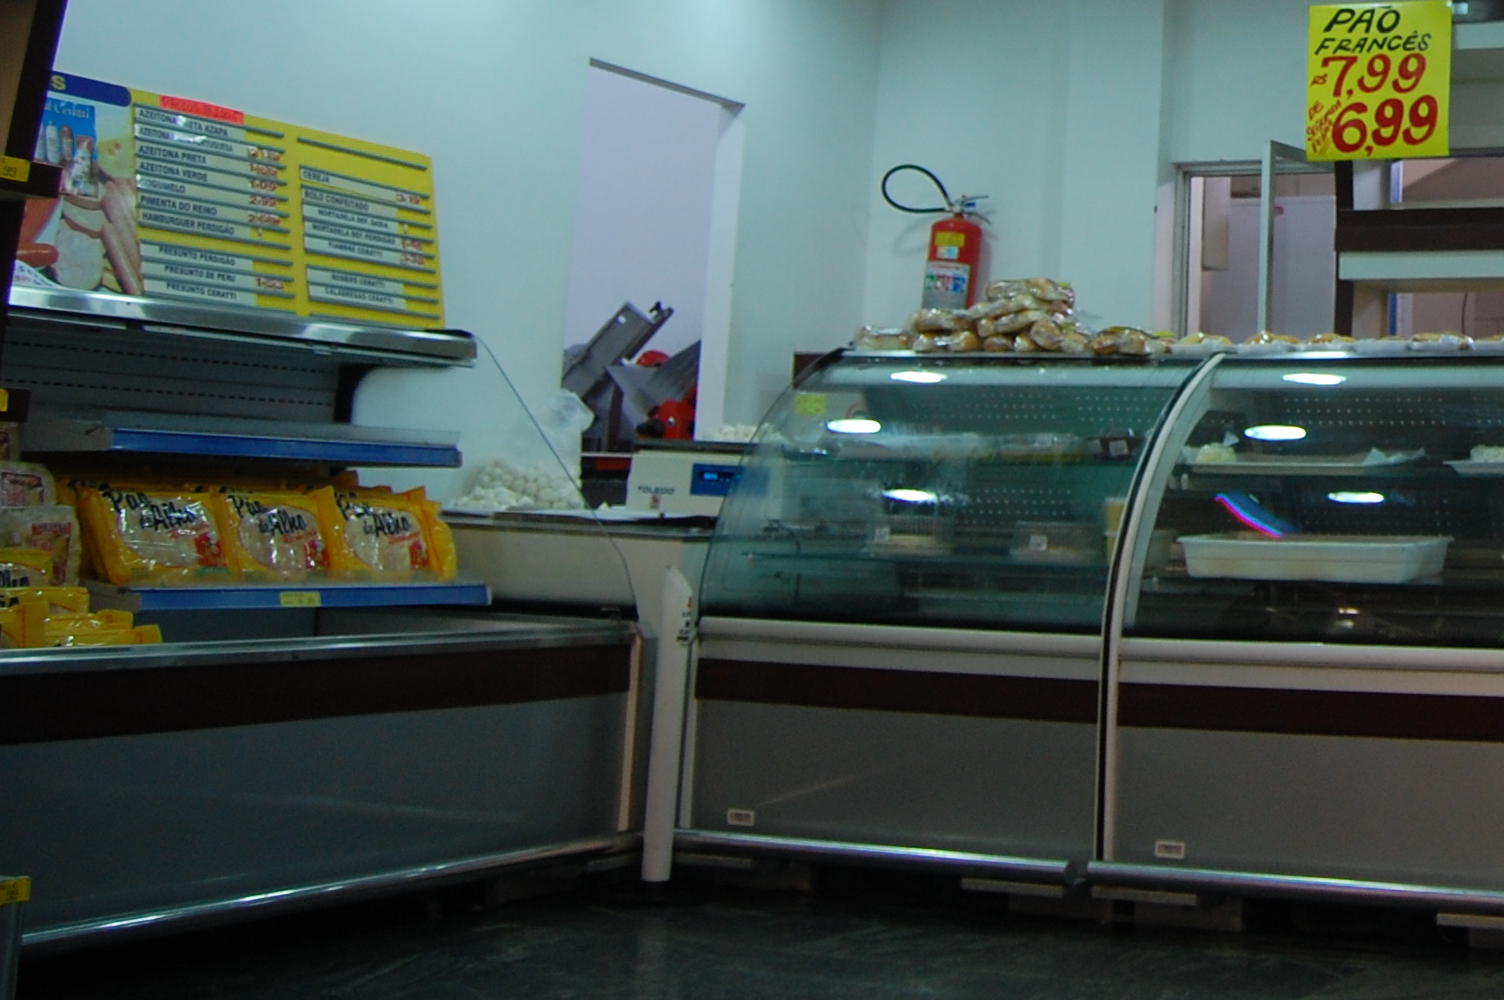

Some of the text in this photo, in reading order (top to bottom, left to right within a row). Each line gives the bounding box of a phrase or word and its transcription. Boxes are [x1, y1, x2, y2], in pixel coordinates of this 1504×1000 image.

[1323, 6, 1401, 34] PÃO
[1314, 30, 1433, 56] FRANCÊS
[1321, 53, 1428, 100] 7,99
[1332, 94, 1439, 157] 6,99
[140, 144, 207, 165] AZEITONA PRETA
[140, 160, 208, 182] AZEITONA VERDE
[140, 195, 178, 210] PIMENTA
[178, 200, 191, 212] DO
[192, 202, 218, 216] REINO
[141, 211, 197, 228] HAMBURGUER
[158, 244, 199, 260] PRESUNTO
[164, 264, 204, 280] PRESUNTO
[166, 281, 206, 296] PRESUNTO
